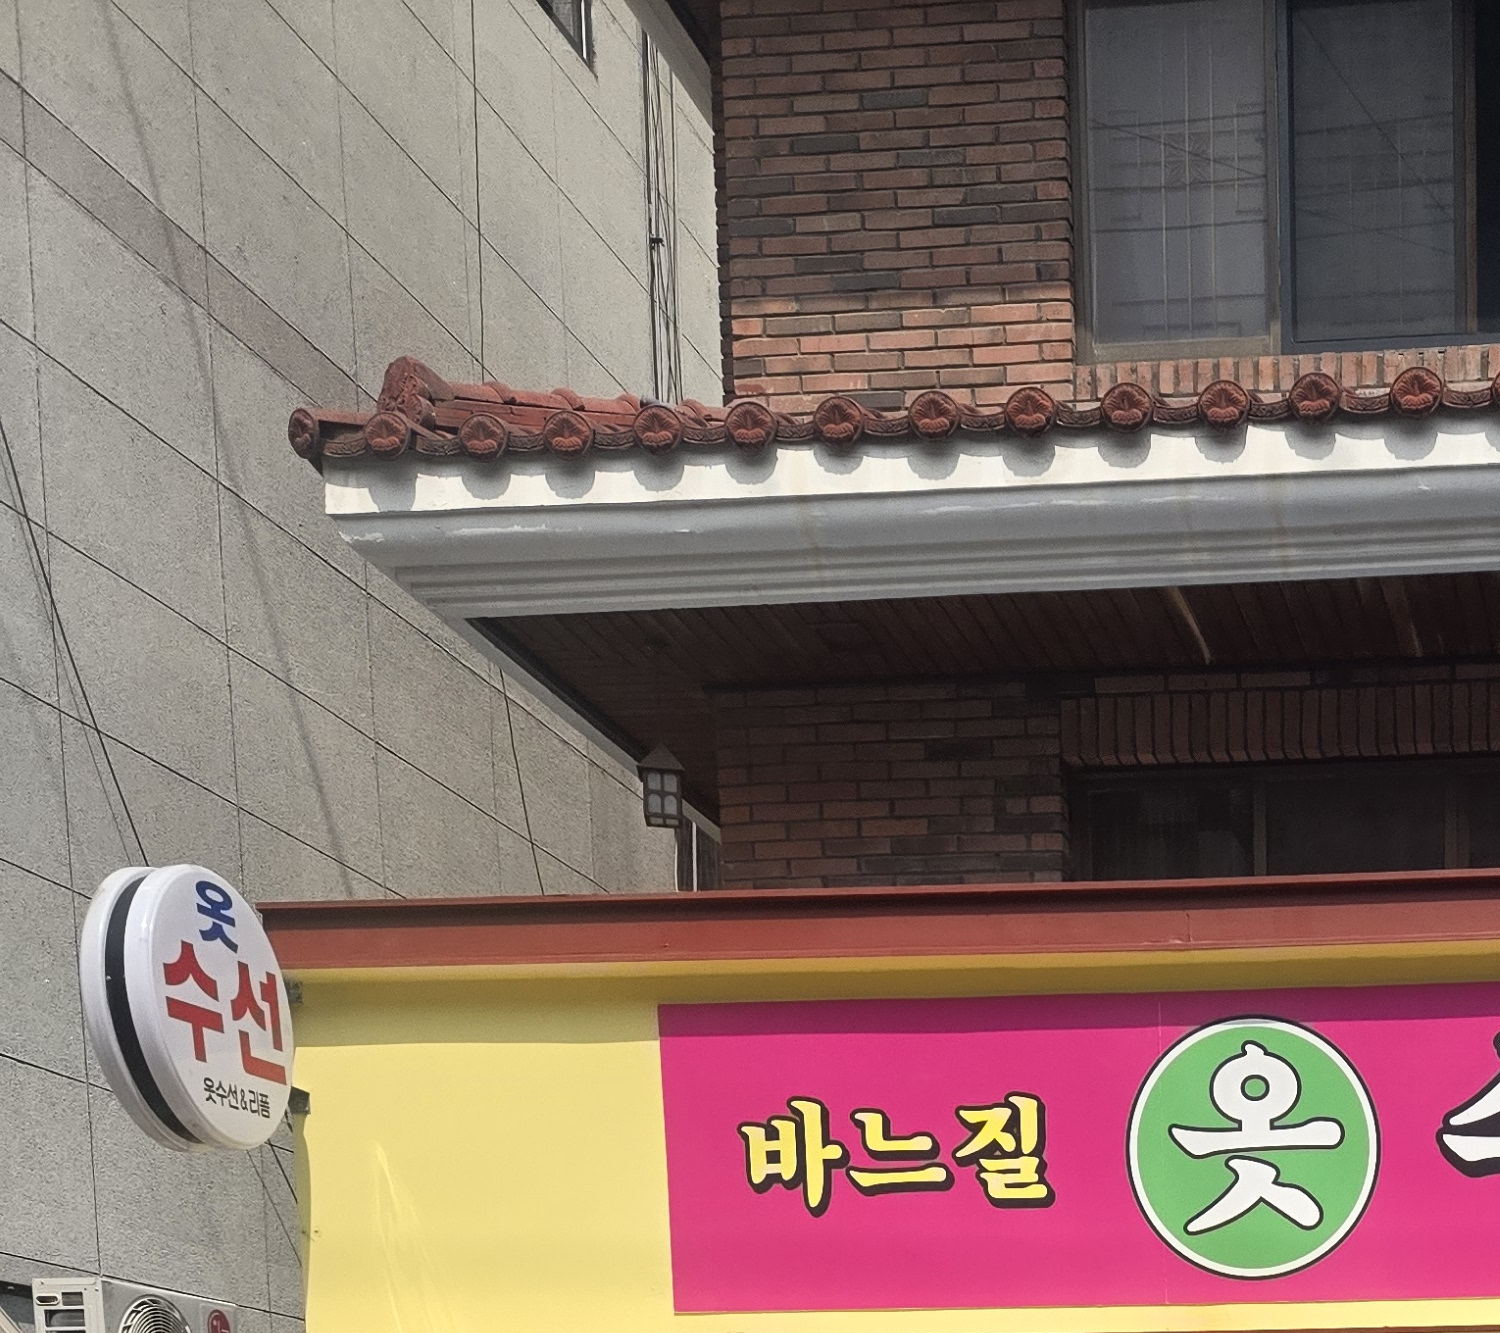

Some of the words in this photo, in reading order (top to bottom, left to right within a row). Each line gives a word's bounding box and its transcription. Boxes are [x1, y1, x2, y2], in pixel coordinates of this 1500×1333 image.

[195, 880, 238, 953] 옷
[163, 939, 287, 1085] 수선
[203, 1077, 271, 1118] 옷수선&리폼
[738, 1092, 1055, 1217] 바느질
[1168, 1041, 1345, 1237] 옷
